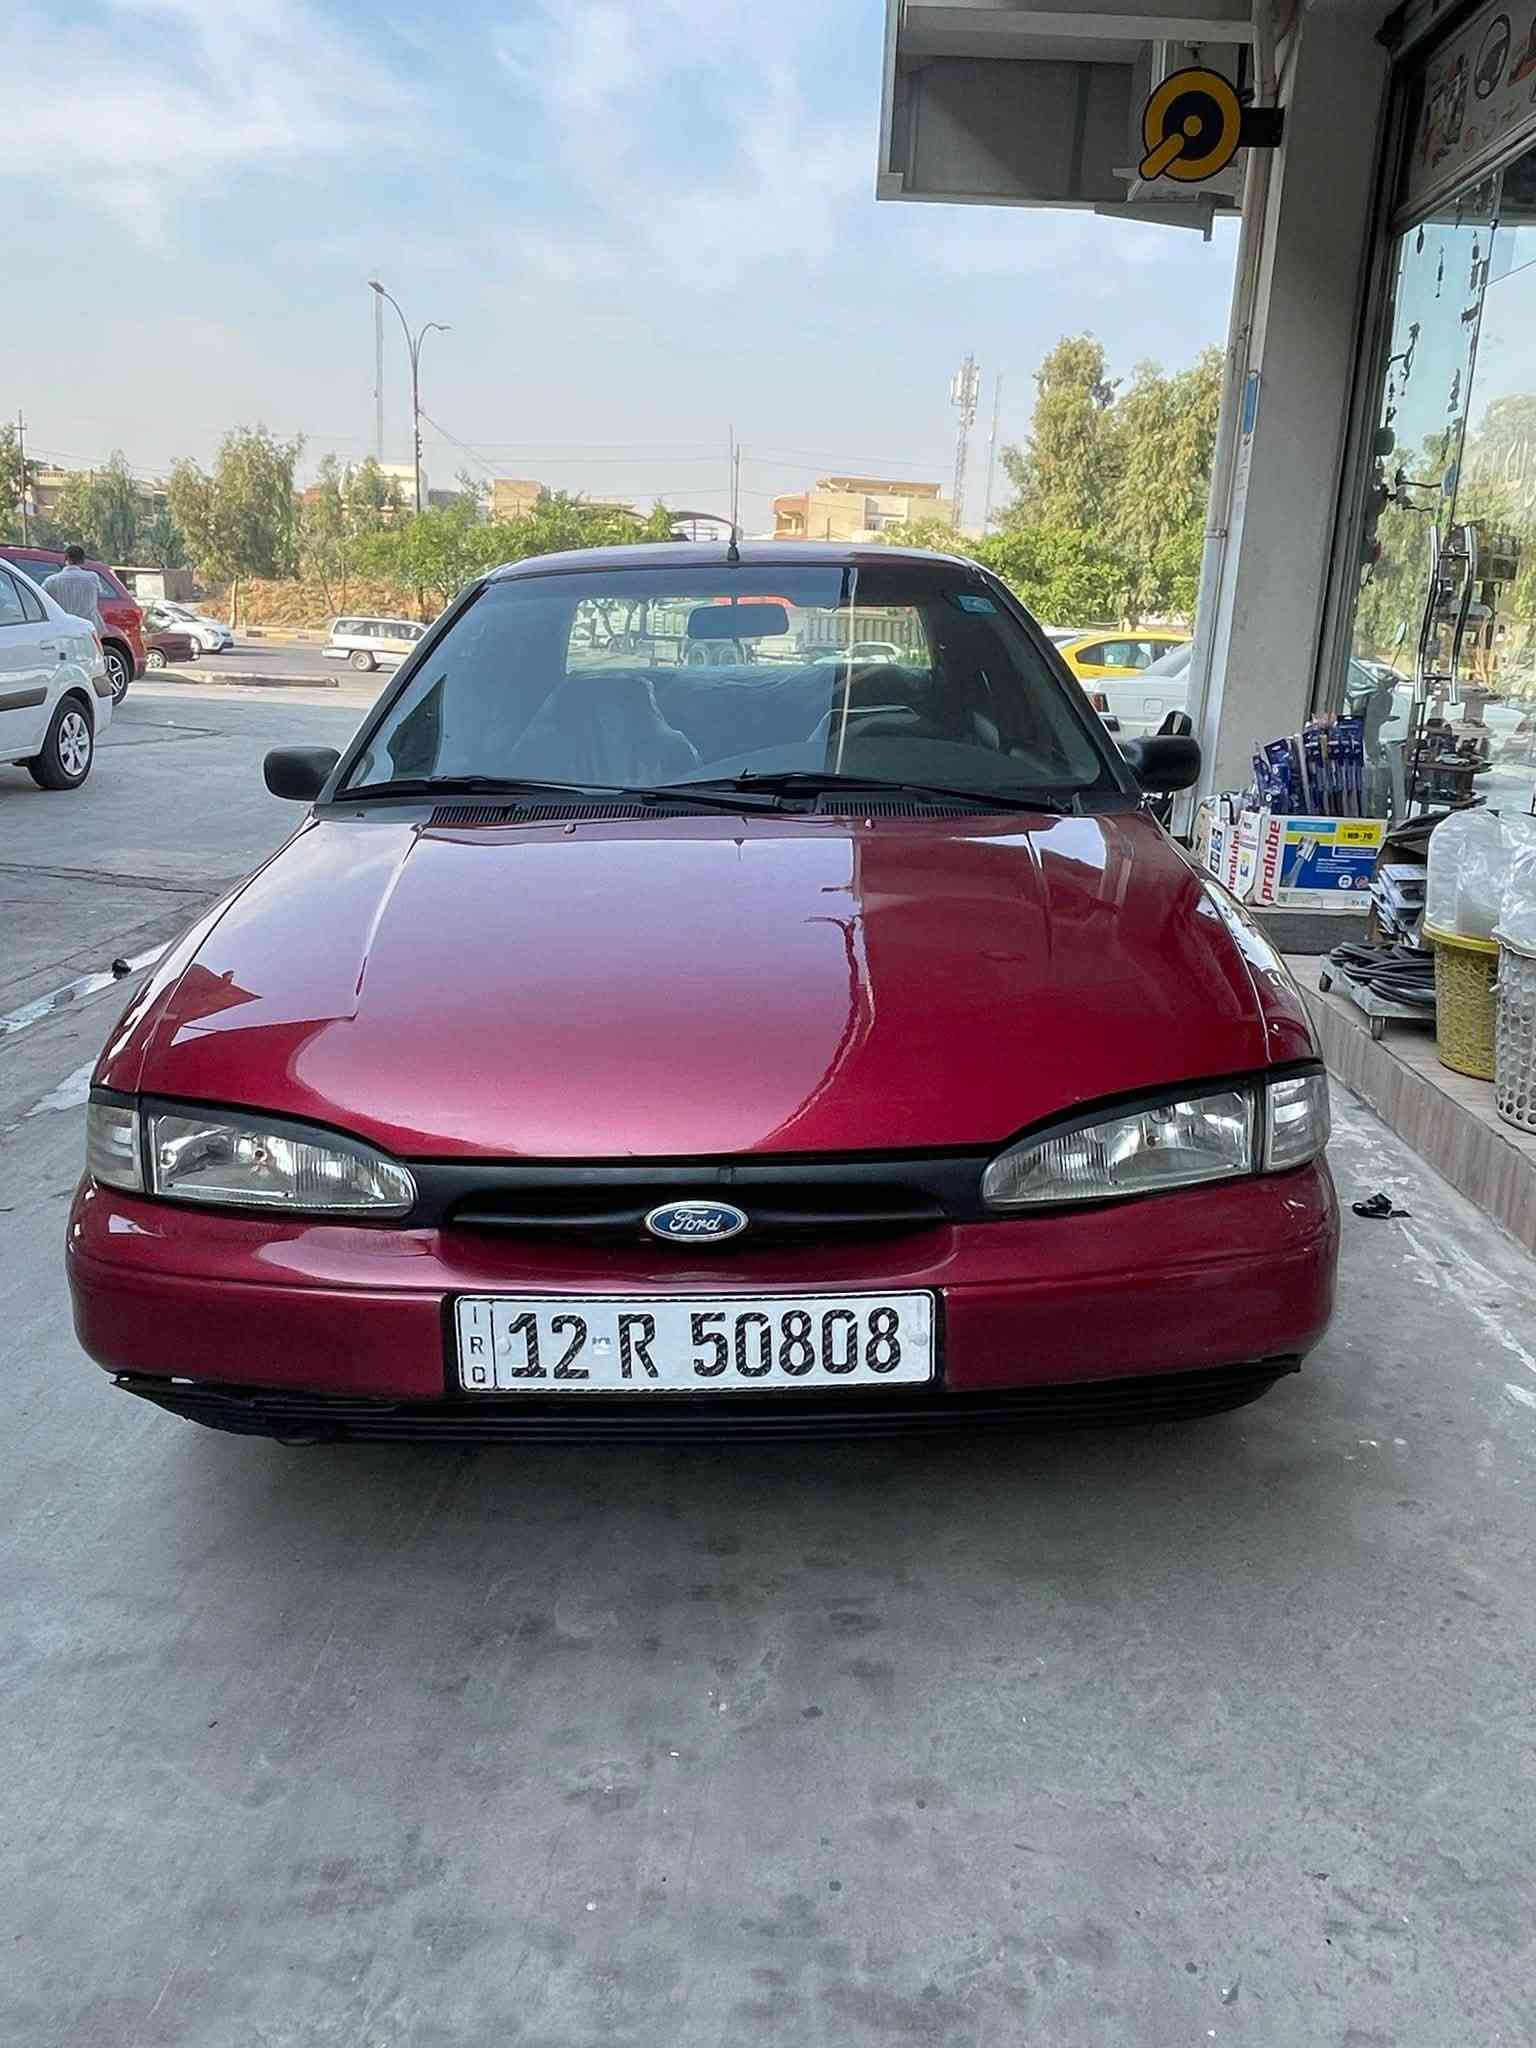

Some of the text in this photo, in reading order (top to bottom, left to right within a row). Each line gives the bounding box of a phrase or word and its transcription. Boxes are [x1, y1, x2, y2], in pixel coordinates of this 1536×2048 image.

[1262, 820, 1281, 901] prolube
[669, 1209, 721, 1232] Ford
[508, 1306, 901, 1380] 12 R 50808
